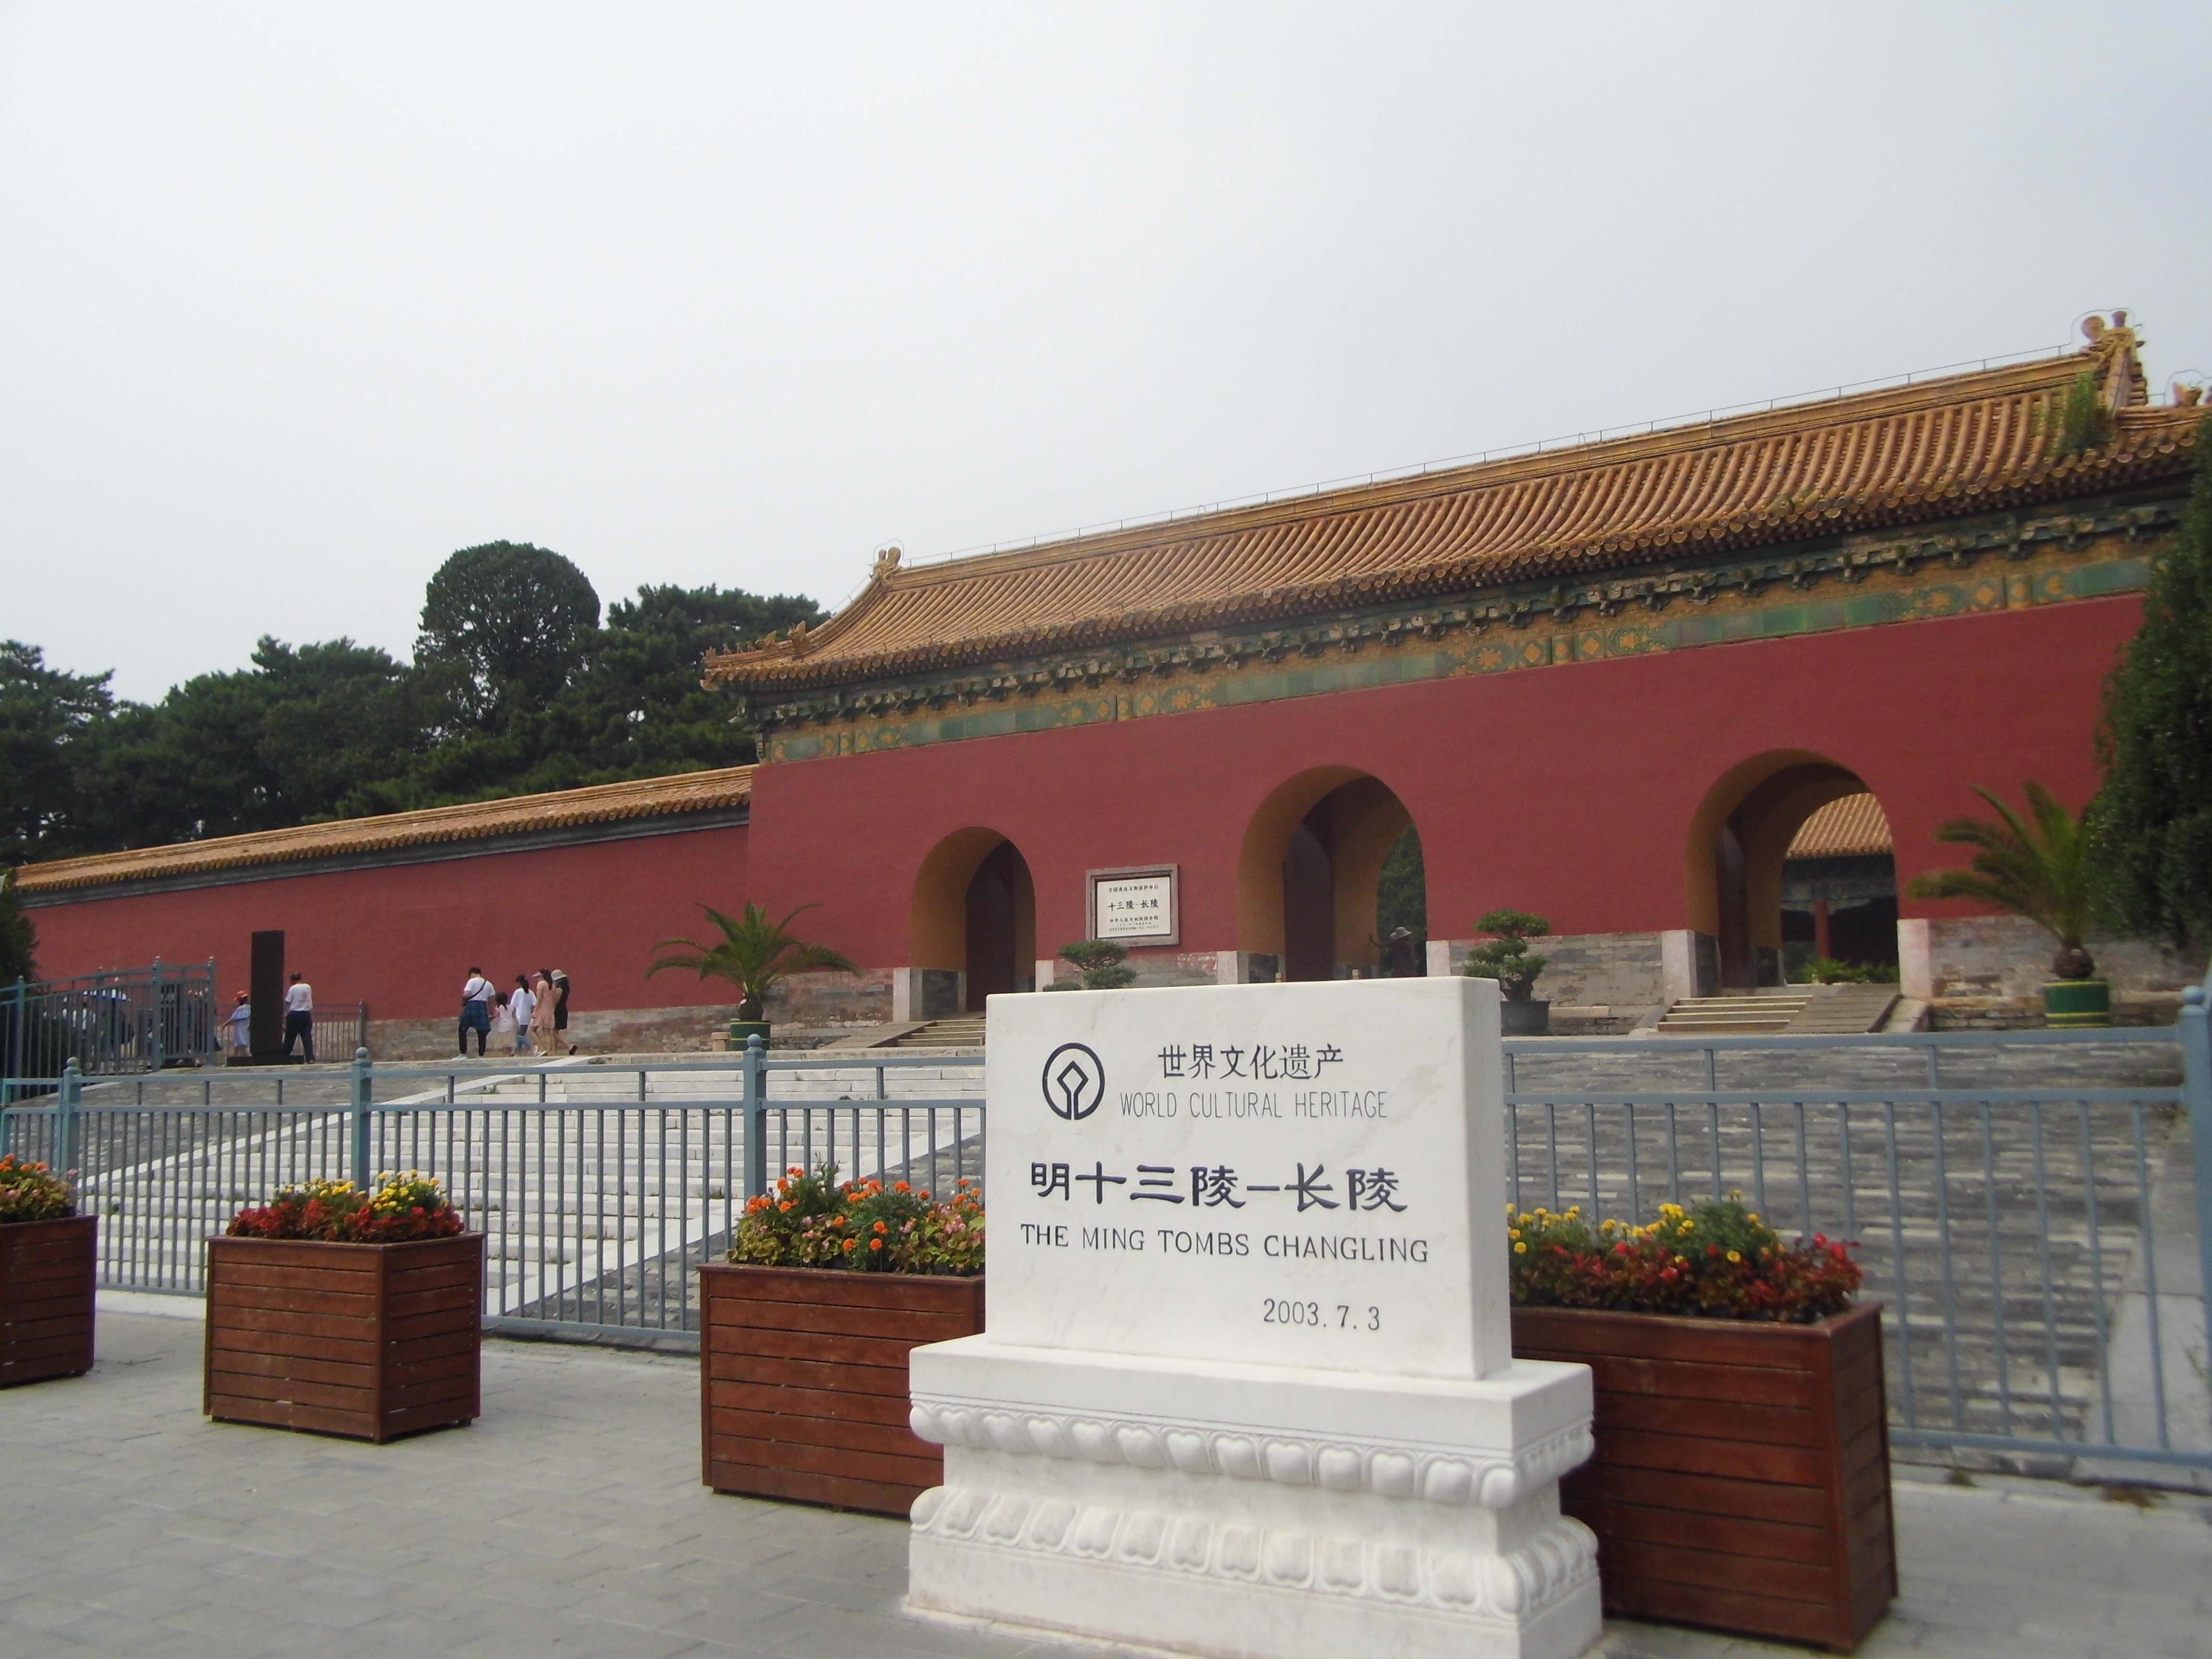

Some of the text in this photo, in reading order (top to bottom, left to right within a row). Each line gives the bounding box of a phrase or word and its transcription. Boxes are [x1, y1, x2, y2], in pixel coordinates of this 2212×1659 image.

[1157, 1043, 1344, 1081] 世界文化遗产
[1120, 1090, 1387, 1119] WORLD CULTURAL HERITAGE
[1020, 1223, 1429, 1262] THE MING TOMBS CHANGLING
